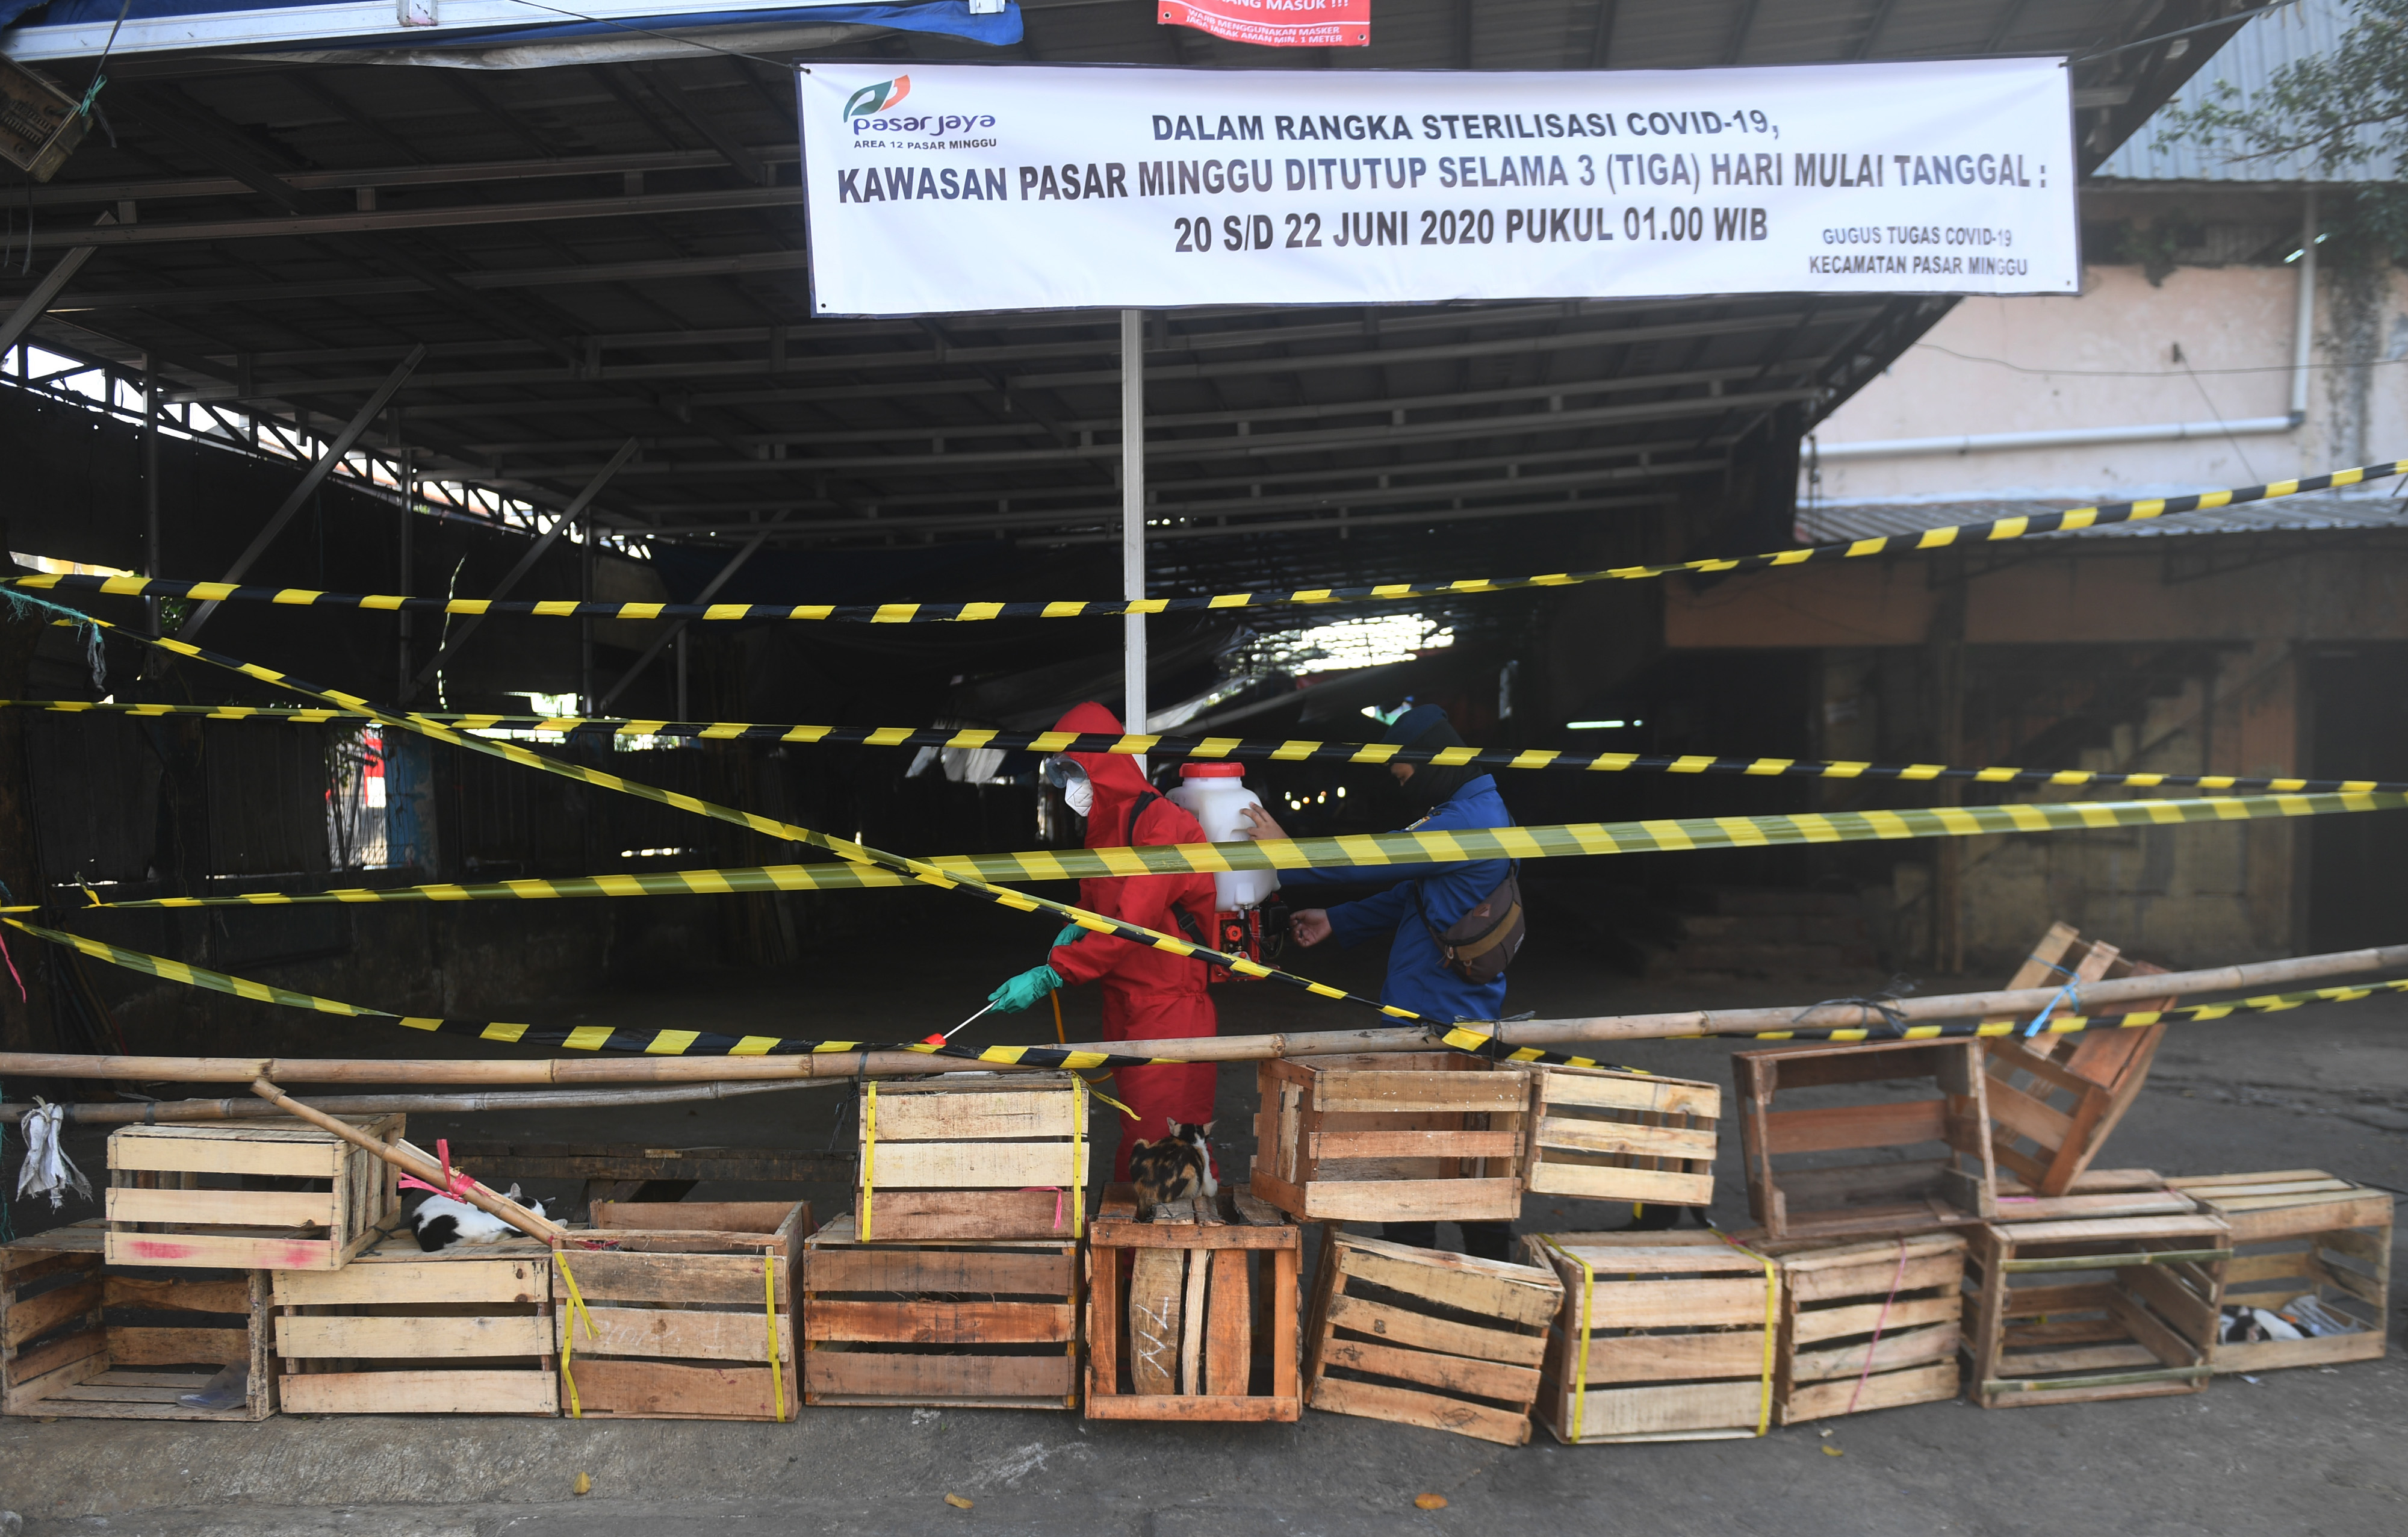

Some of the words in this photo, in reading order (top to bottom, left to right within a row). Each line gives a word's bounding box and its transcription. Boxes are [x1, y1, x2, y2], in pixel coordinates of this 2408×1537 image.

[1186, 15, 1209, 29] JAGA
[1210, 25, 1239, 38] JARAK
[1241, 33, 1272, 43] AMAN
[1309, 35, 1342, 43] METER
[1218, 19, 1296, 36] MENGGUNAKAN
[1299, 26, 1340, 36] MASKER
[1152, 114, 1265, 141] DALAM
[1274, 114, 1414, 141] RANGKA
[1421, 113, 1618, 140] STERILISASI
[1626, 109, 1779, 140] COVID-19,
[854, 140, 886, 149] AREA
[907, 141, 946, 150] PASAR
[949, 138, 997, 150] MINGGU
[837, 166, 1008, 203] KAWASAN
[1019, 162, 1129, 201] PASAR
[1138, 158, 1273, 197] MINGGU
[1285, 157, 1427, 191] DITUTUP
[1438, 155, 1569, 188] SELAMA
[1577, 154, 1595, 186] 3
[1606, 153, 1700, 195] (TIGA)
[1711, 152, 1783, 186] HARI
[1795, 152, 1883, 188] MULAI
[1174, 216, 1212, 253] 20
[1223, 214, 1274, 252] S/D
[1284, 212, 1323, 249] 22
[1332, 210, 1408, 247] JUNI
[1420, 208, 1494, 245] 2020
[1506, 207, 1614, 243] PUKUL
[1623, 206, 1704, 241] 01.00
[1713, 206, 1767, 241] WIB
[1823, 226, 1881, 245] GUGUS
[1887, 226, 1940, 245] TUGAS
[1946, 227, 2012, 247] COVID-19
[1809, 255, 1907, 274] KECAMATAN
[1913, 255, 1963, 275] PASAR
[1969, 256, 2028, 276] MINGGU
